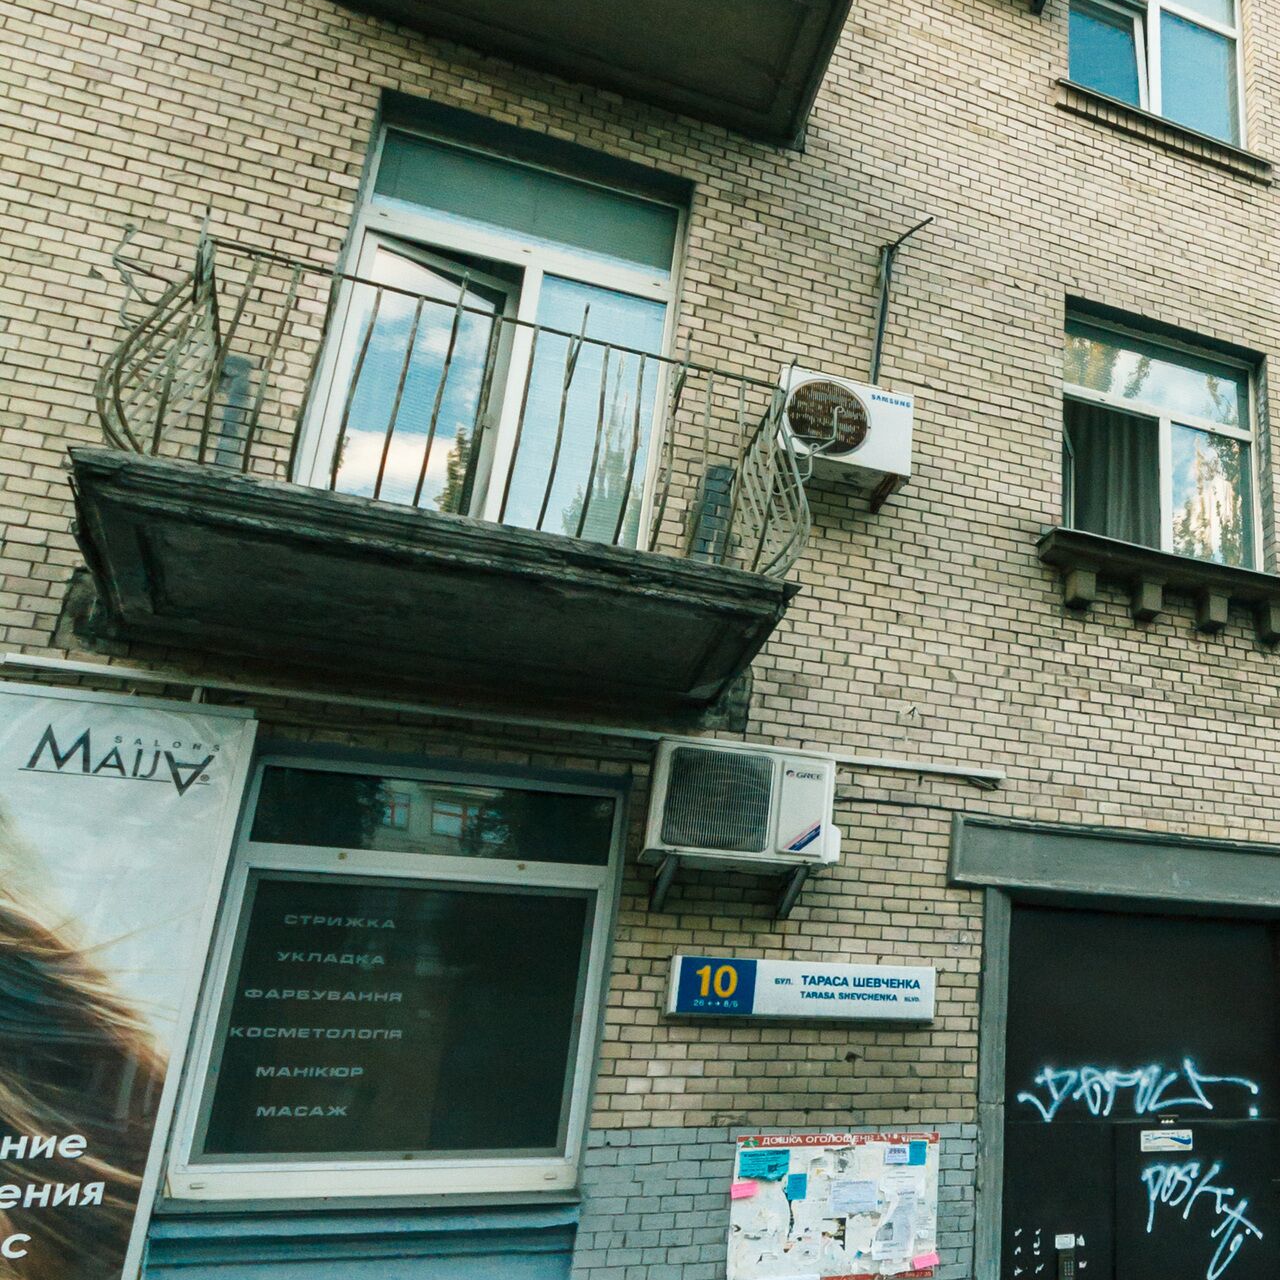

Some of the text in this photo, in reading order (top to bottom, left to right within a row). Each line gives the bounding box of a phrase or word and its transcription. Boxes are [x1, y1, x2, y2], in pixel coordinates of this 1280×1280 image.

[871, 393, 912, 408] SAMSUNG
[114, 734, 220, 752] SALONS
[284, 914, 396, 929] СТРИЖКА
[277, 951, 385, 965] УКЛАДКА
[696, 965, 739, 998] 10
[774, 975, 921, 990] БУЛ. ТАРАСА ШЕВЧЕНКА
[244, 989, 403, 1003] ФАРБУВАННЯ
[800, 991, 835, 1000] TARASA
[838, 992, 898, 1002] SHEVCHENKA
[229, 1026, 403, 1040] КОСМЕТОЛОГІЯ
[256, 1066, 364, 1078] МАНІКЮР
[256, 1105, 348, 1117] МАСАЖ
[762, 1135, 803, 1145] ДОШКА
